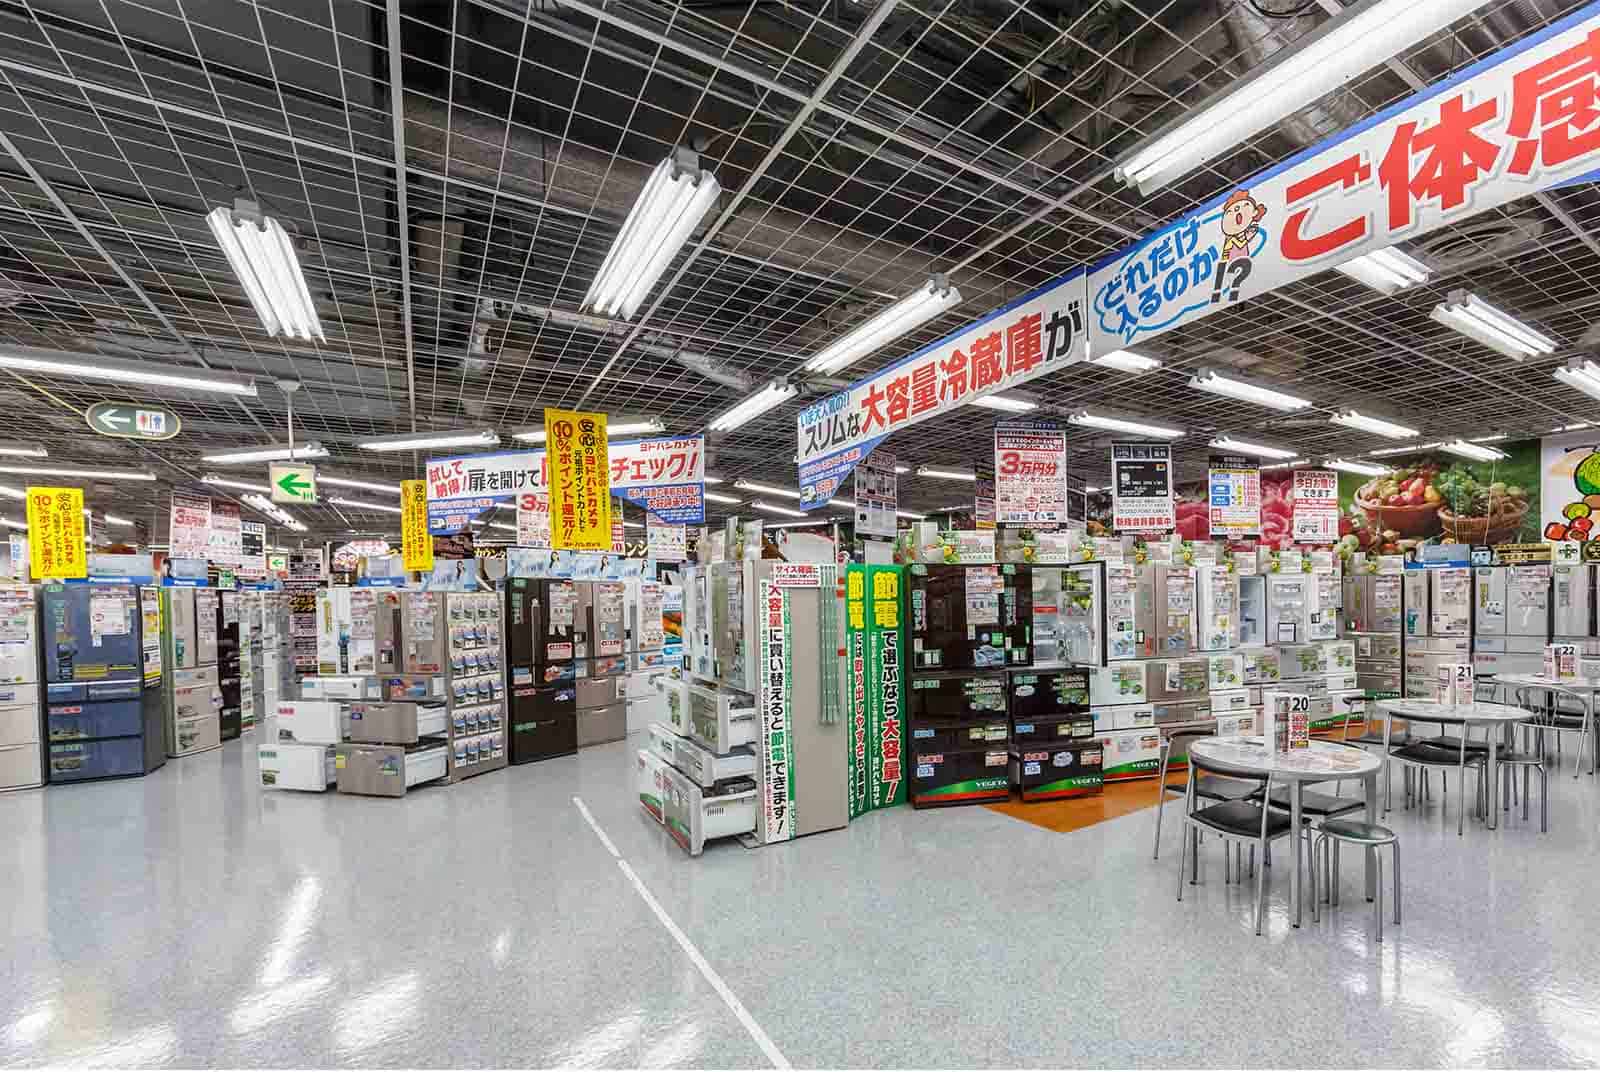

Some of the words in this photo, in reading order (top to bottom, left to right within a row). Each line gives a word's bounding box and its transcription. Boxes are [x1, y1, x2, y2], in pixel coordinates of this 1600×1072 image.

[1101, 217, 1204, 312] どれだけ
[804, 300, 1084, 456] スリムな大容量冷蔵庫が
[640, 440, 697, 452] ヨドバシカメラ
[430, 461, 463, 483] 試して
[611, 452, 698, 481] チェック!
[1001, 452, 1057, 476] 3万円分
[468, 469, 540, 492] 扉を開けて
[1561, 646, 1575, 655] 22
[1457, 666, 1472, 677] 21
[1292, 696, 1309, 711] 20
[976, 779, 1007, 787] VEGETA
